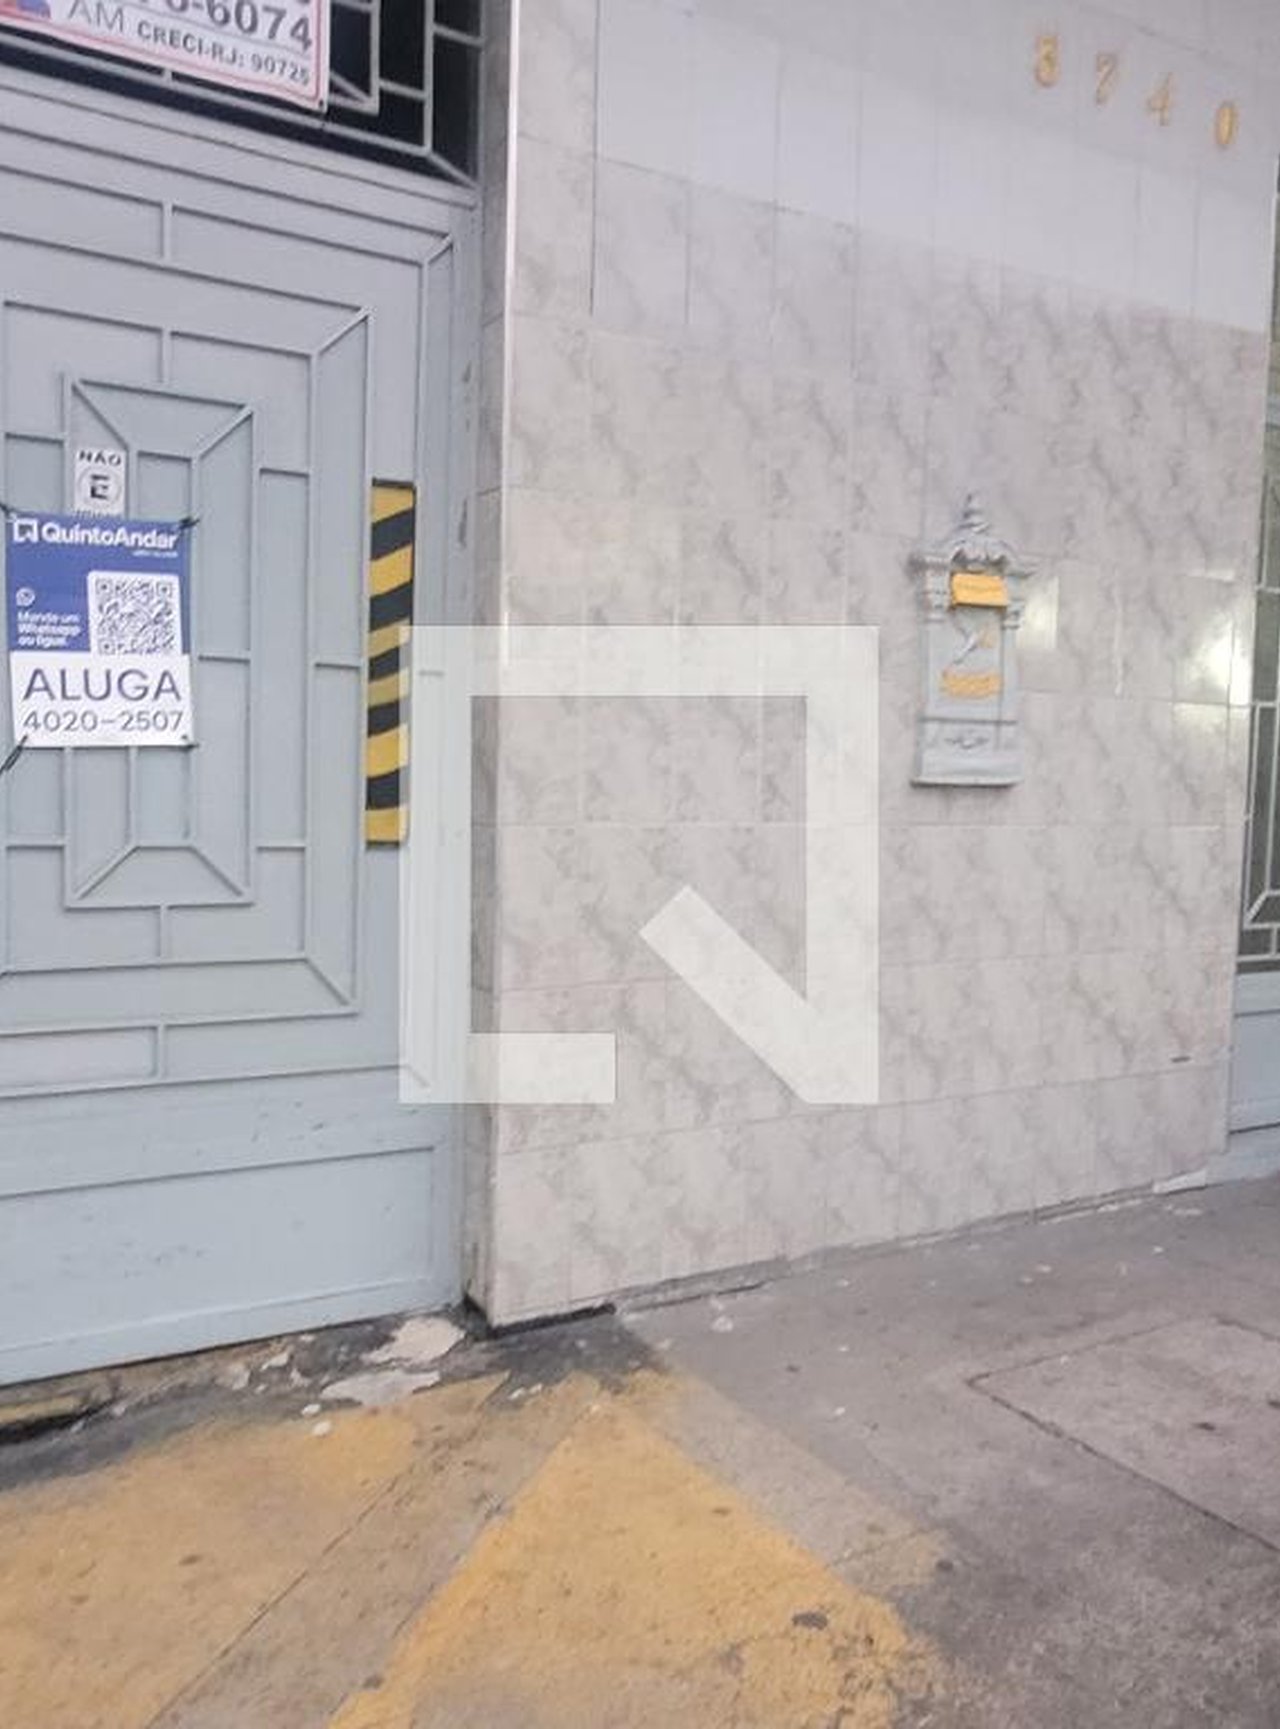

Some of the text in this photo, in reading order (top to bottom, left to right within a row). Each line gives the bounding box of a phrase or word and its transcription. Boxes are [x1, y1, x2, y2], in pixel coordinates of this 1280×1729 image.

[137, 20, 311, 86] CRECI-RJ: 90725
[1034, 34, 1238, 150] 3740
[41, 521, 178, 550] QuintoAndar
[23, 668, 182, 702] ALUGA
[23, 709, 183, 733] 4020-2507
